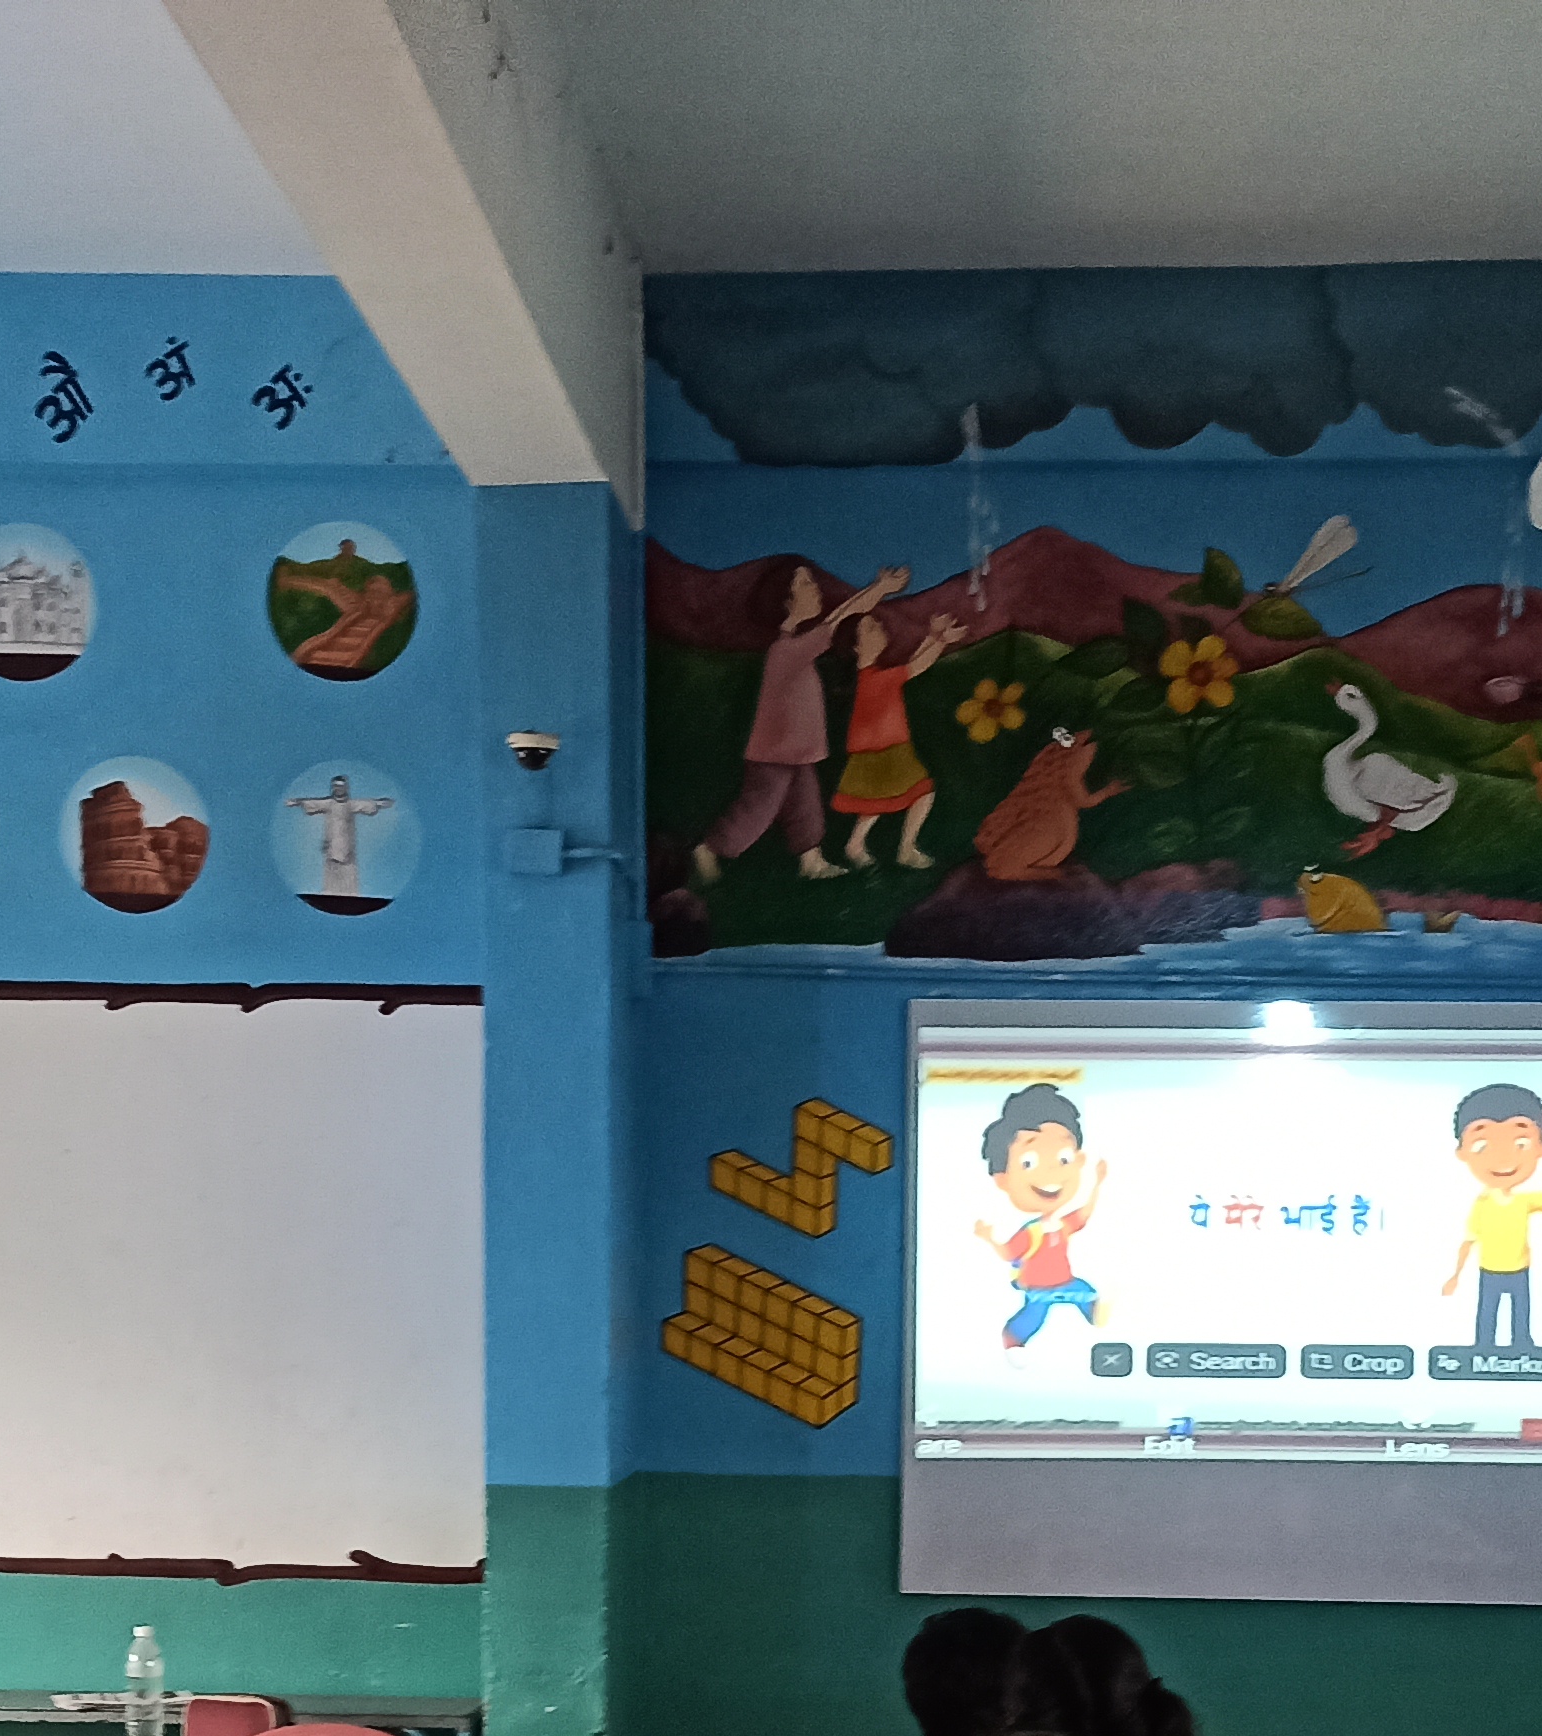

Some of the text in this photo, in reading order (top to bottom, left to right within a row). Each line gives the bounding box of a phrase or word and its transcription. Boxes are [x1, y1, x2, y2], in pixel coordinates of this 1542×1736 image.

[34, 350, 95, 444] औ
[144, 336, 196, 402] अं
[251, 363, 314, 431] अः
[1188, 1194, 1212, 1228] ये
[1222, 1194, 1265, 1230] मेरे
[1280, 1194, 1337, 1235] भाई
[1189, 1351, 1277, 1372] Search
[1343, 1353, 1406, 1376] Crop
[1143, 1435, 1197, 1455] Edit
[1384, 1439, 1451, 1459] Lens
